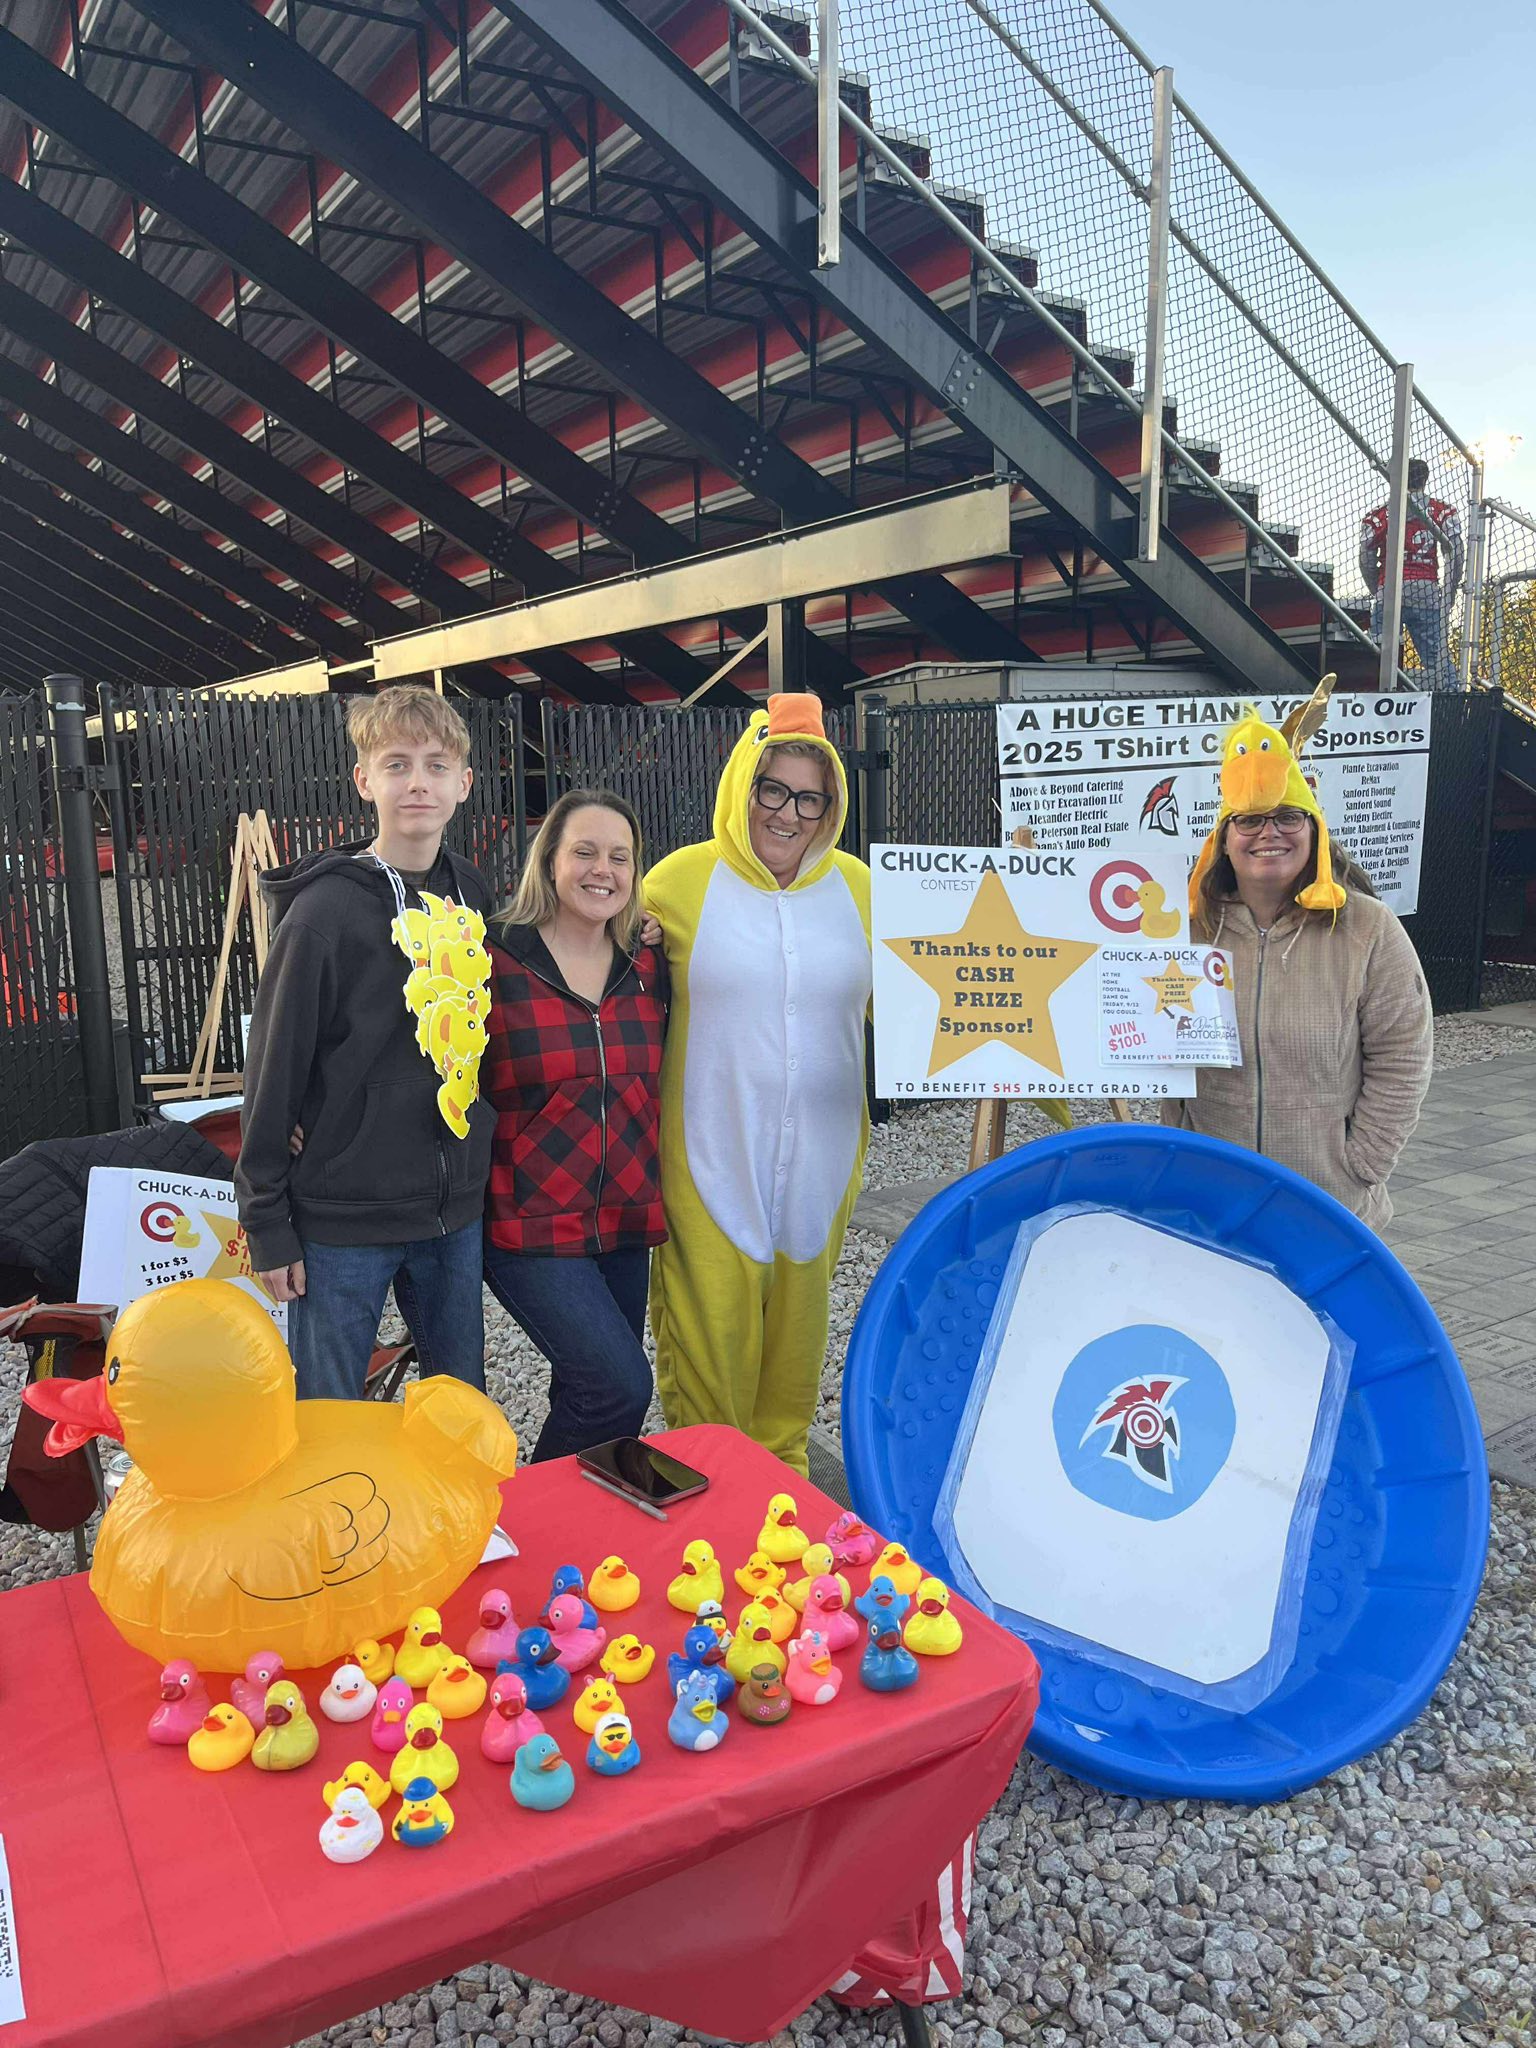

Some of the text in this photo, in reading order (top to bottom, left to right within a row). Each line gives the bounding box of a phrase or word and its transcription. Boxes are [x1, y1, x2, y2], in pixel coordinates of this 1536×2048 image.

[1016, 709, 1041, 731] A
[1053, 705, 1145, 729] HUGE
[1337, 699, 1365, 717] To
[1374, 698, 1418, 716] Our
[1003, 740, 1083, 765] 2025
[1094, 735, 1190, 760] TShirt
[1313, 728, 1425, 751] Sponsors
[1009, 779, 1124, 798] Above & Beyond Catering
[1343, 786, 1396, 799] Sanford Flooring
[1010, 793, 1124, 812] Alex D Cyr Excavation LLC
[1346, 799, 1392, 811] Sanford Sound
[1027, 809, 1108, 826] Alexander Electric
[1187, 814, 1214, 825] Landry
[1041, 826, 1079, 839] Peterson
[1081, 823, 1102, 835] Real
[1104, 821, 1130, 833] Estate
[1065, 839, 1085, 850] Auto
[1088, 836, 1111, 849] Body
[1361, 835, 1389, 846] Cleaning
[1390, 833, 1414, 843] Services
[1360, 848, 1383, 859] Village
[1385, 845, 1409, 856] Carwash
[880, 851, 1076, 876] CHUCK-A-DUCK
[1361, 861, 1379, 871] Signs
[1387, 856, 1410, 867] Designs
[921, 879, 977, 891] CONTEST
[910, 940, 1058, 958] Thanks to our
[1102, 951, 1198, 962] CHUCK-A-DUCK
[955, 966, 1015, 982] CASH
[954, 992, 1023, 1008] PRIZE
[939, 1017, 1033, 1036] Sponsor!
[1109, 1020, 1137, 1036] WIN
[1108, 1033, 1147, 1051] $100!
[896, 1082, 1168, 1093] TO BENEFIT SHS PROJECT GRAD '26
[137, 1180, 236, 1203] CHUCK-A-DU
[141, 1256, 189, 1273] 1 for $3
[145, 1270, 195, 1287] 3 for $5
